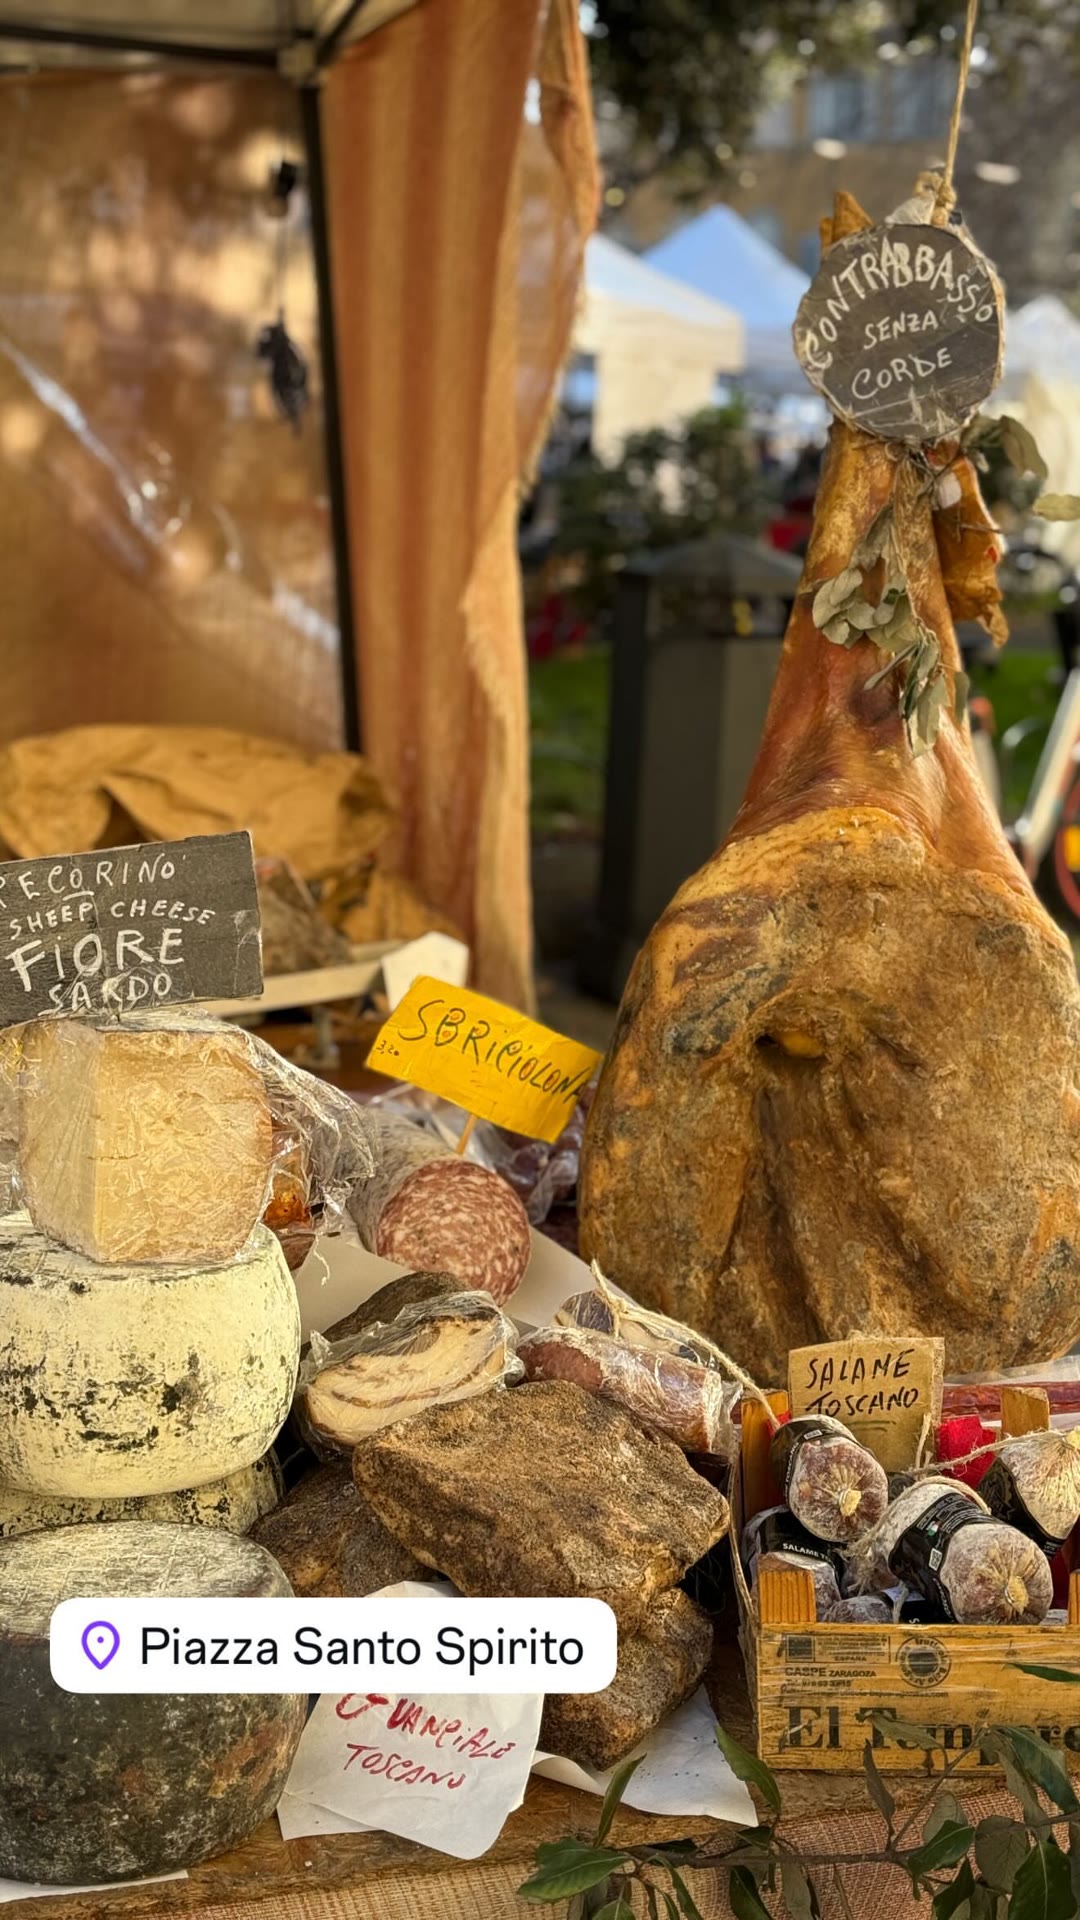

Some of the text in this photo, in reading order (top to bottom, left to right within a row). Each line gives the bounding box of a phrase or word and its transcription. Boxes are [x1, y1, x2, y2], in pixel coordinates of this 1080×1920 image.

[805, 236, 994, 369] CONTRABBASSO
[863, 310, 939, 350] SENZA
[852, 347, 952, 400] CORDE
[10, 899, 216, 941] SHEEP CHEESE
[38, 972, 171, 1016] SARDO
[806, 1348, 915, 1391] SALAME
[805, 1386, 919, 1418] TOSCANO
[782, 1543, 819, 1558] SALAME
[784, 1667, 877, 1678] CASPE ZARAGOZA
[784, 1706, 842, 1749] El
[344, 1743, 466, 1789] TOSCANO
